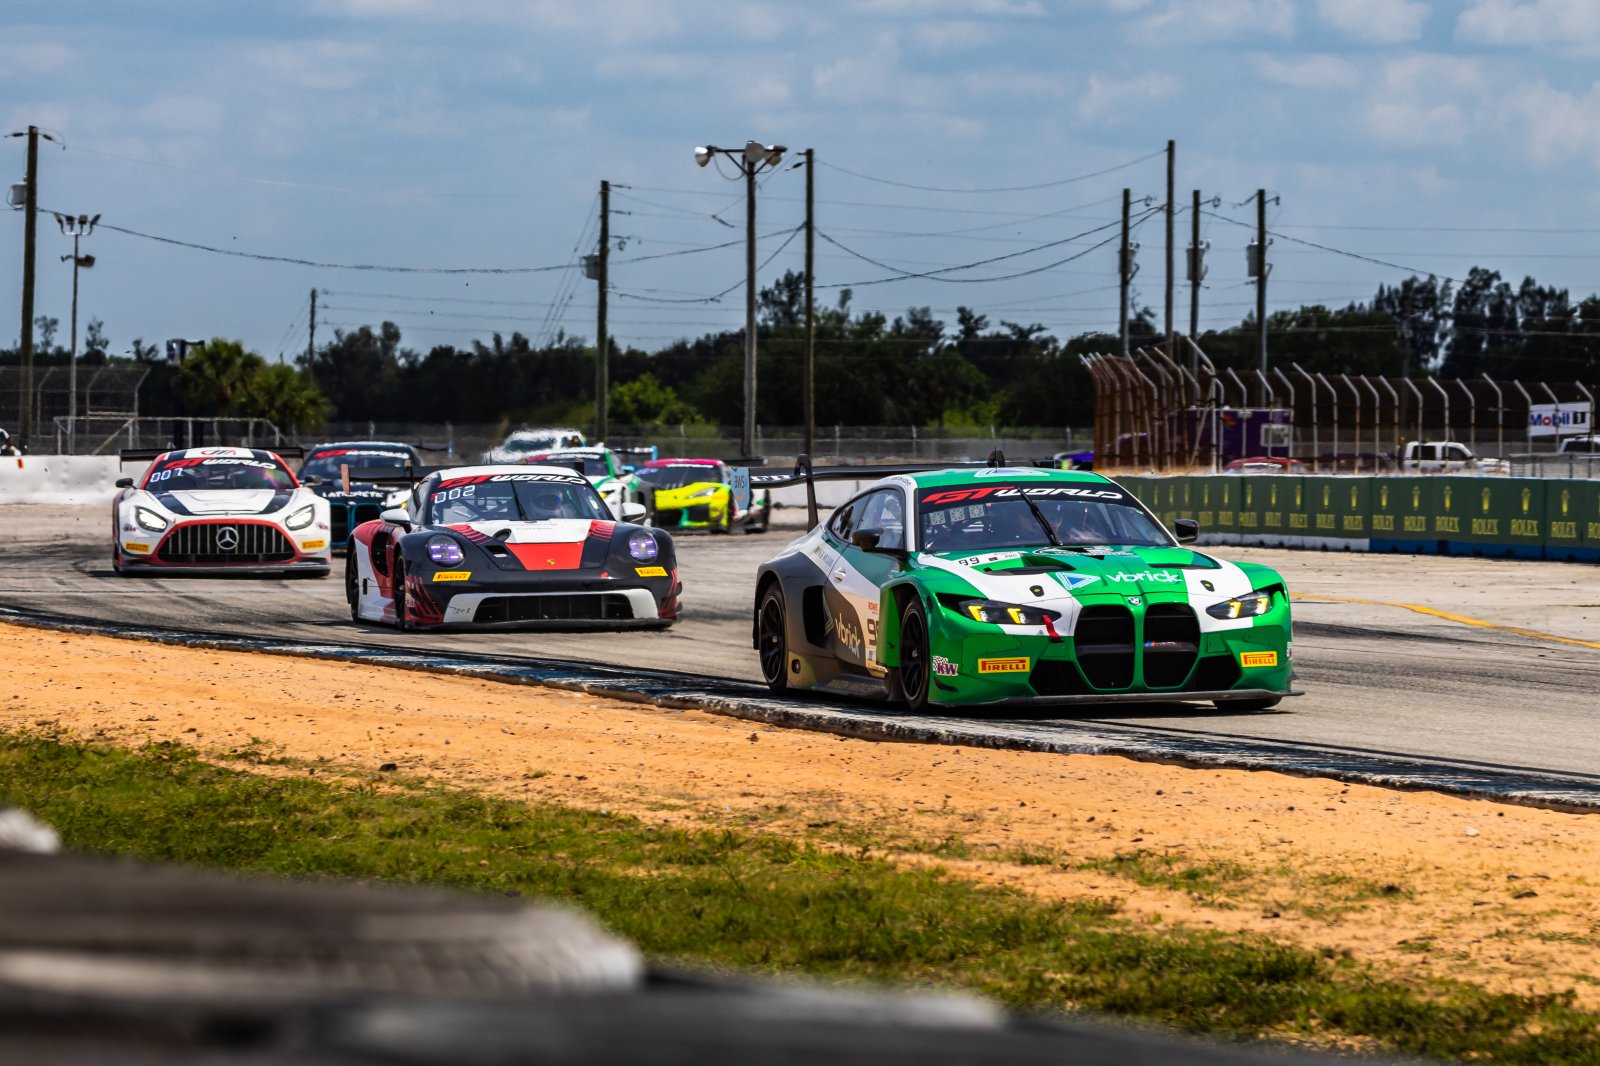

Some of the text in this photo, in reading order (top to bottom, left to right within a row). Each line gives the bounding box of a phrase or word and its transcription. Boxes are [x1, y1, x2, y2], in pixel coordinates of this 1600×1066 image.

[1530, 412, 1570, 426] Mobil
[434, 485, 475, 504] 002
[1404, 516, 1427, 532] ROLEX
[1436, 516, 1460, 533] ROLEX
[1472, 519, 1499, 535] ROLEX
[1511, 519, 1539, 537] ROLEX
[1551, 521, 1577, 538] ROLEX
[958, 557, 980, 566] 99
[1105, 570, 1184, 583] vbrick
[981, 659, 1027, 671] PIRELLI
[1243, 653, 1275, 665] PIRELLI
[936, 661, 959, 676] KW
